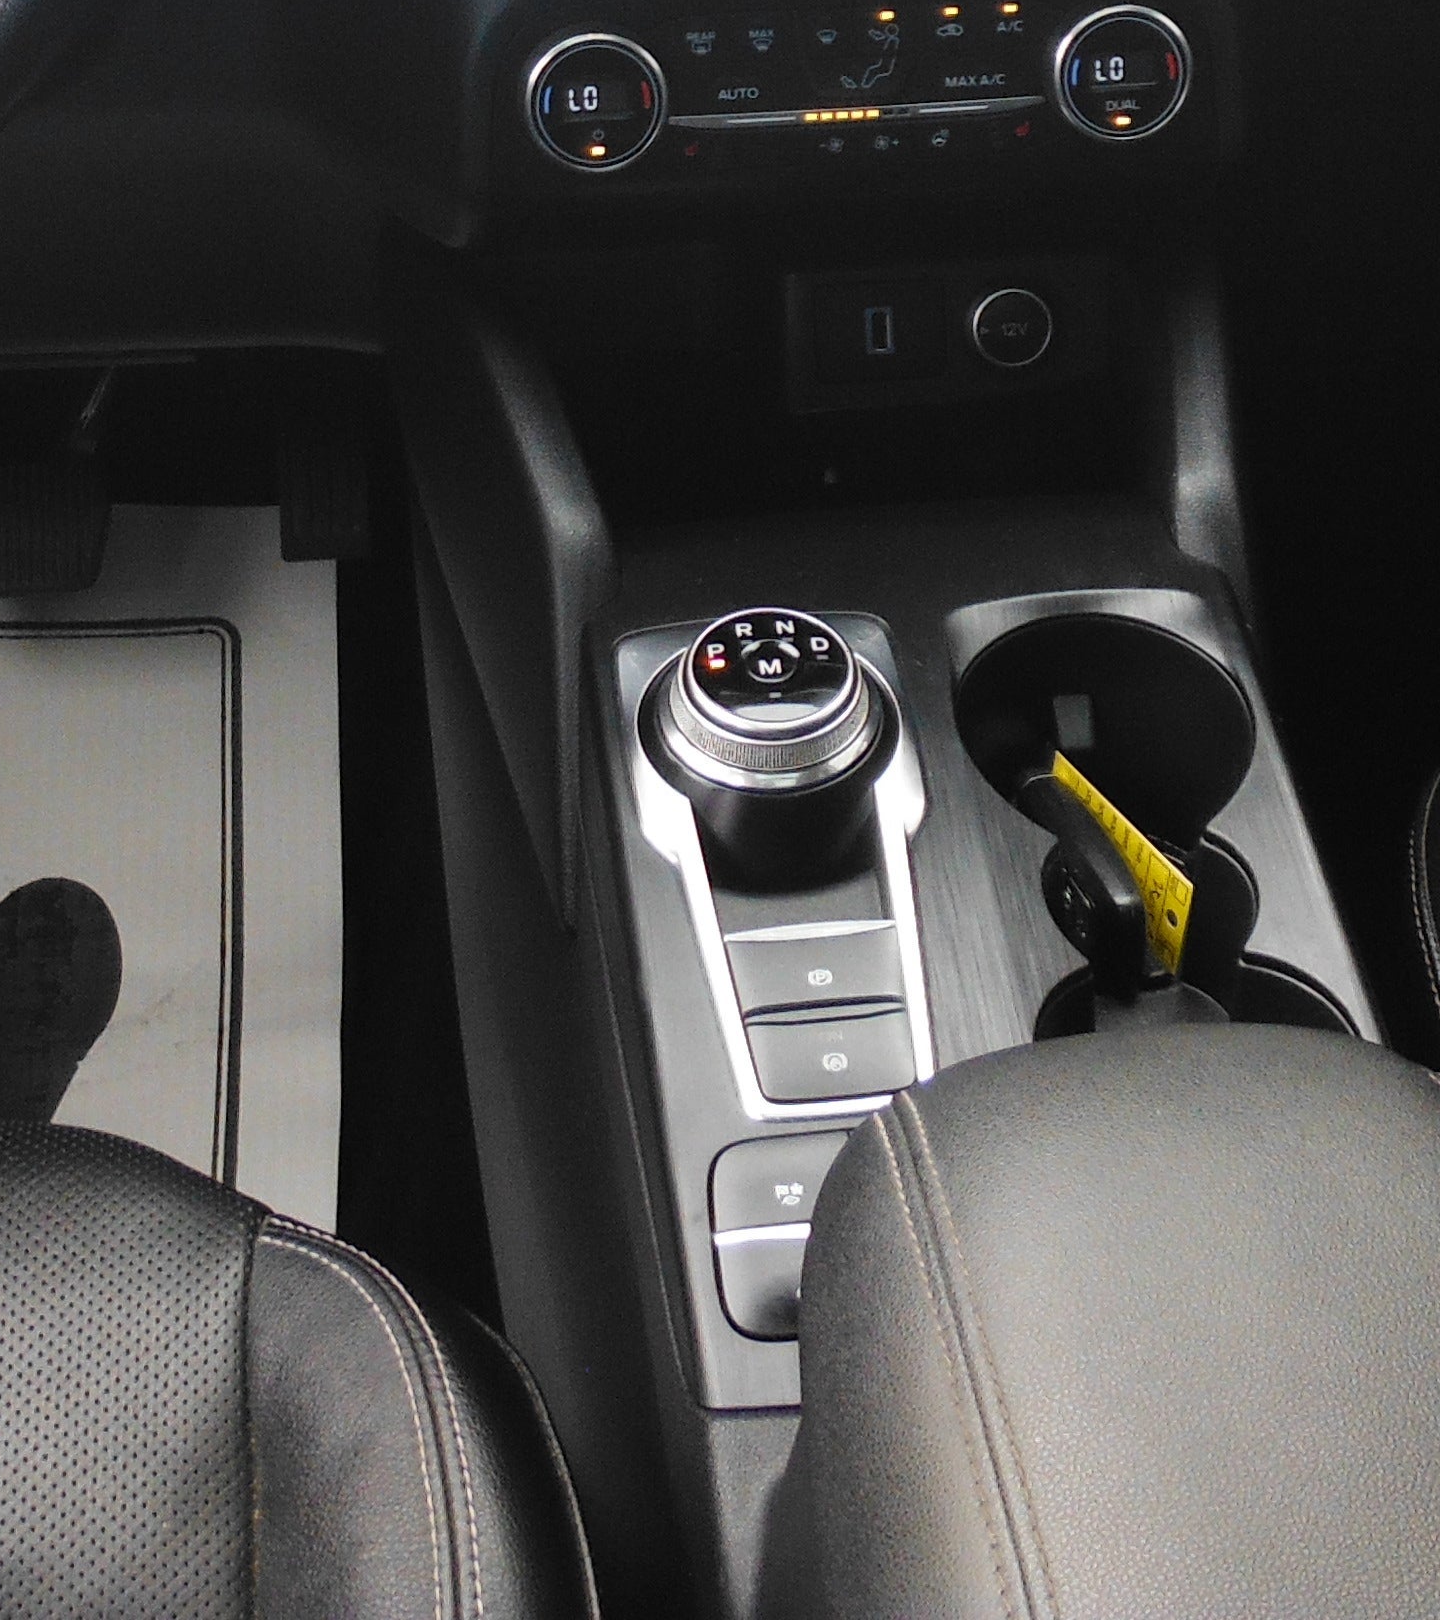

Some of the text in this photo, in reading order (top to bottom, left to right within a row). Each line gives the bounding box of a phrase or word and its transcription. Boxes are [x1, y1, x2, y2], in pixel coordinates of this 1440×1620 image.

[995, 19, 1024, 32] A/C
[685, 31, 717, 41] REAR
[748, 29, 775, 38] MAX
[944, 73, 1006, 88] MAX A/C
[717, 86, 760, 101] AUTO
[1105, 99, 1141, 112] DUAL
[734, 622, 753, 637] R
[775, 619, 795, 635] N
[706, 643, 725, 659] P
[810, 636, 830, 652] D
[757, 658, 783, 676] M
